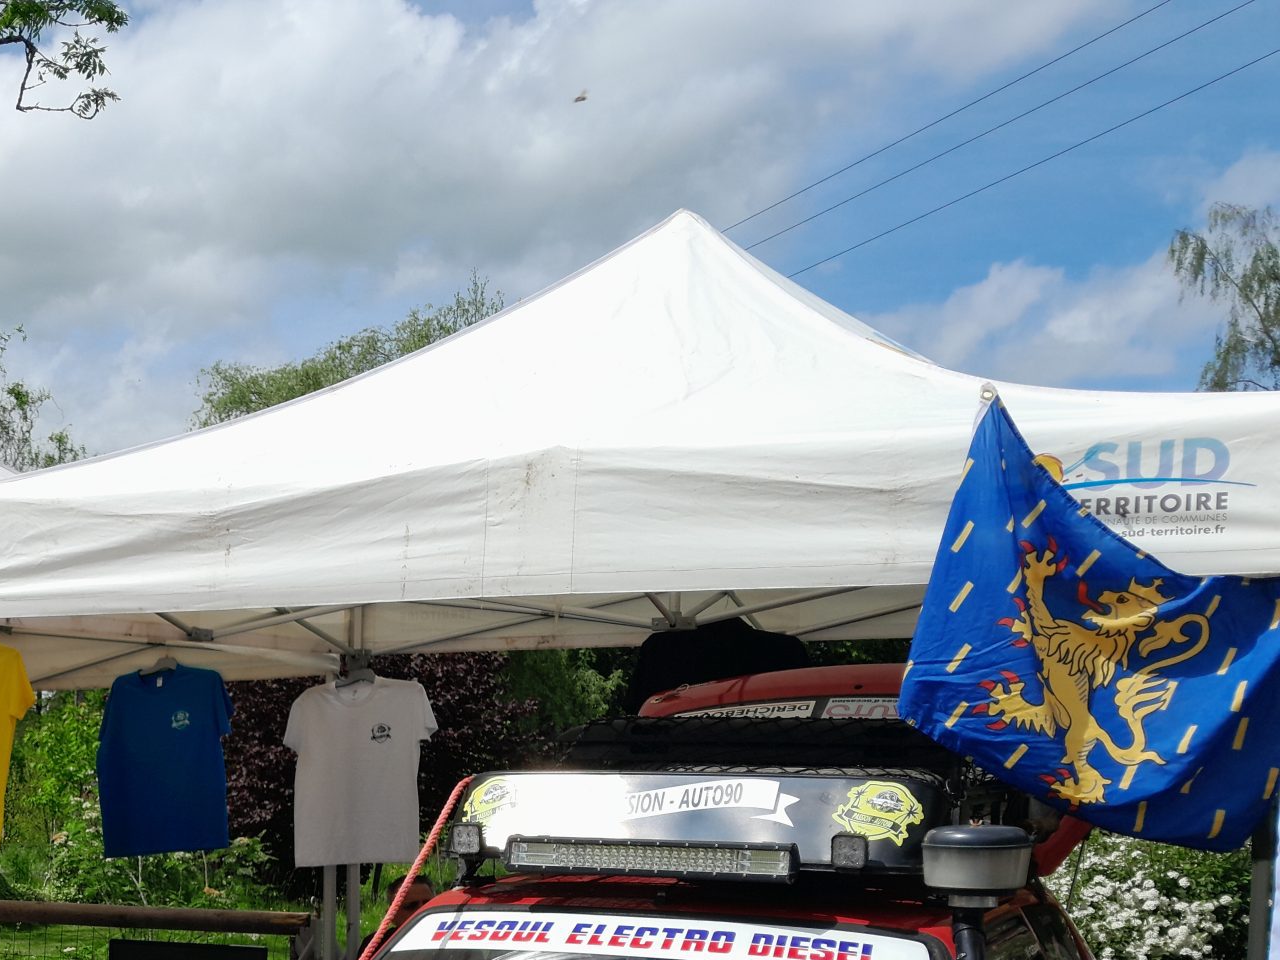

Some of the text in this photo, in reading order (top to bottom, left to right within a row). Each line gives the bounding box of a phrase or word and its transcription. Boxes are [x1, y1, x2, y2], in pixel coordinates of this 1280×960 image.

[1083, 437, 1230, 491] SUD
[1082, 491, 1228, 516] ERRITOIRE
[1118, 525, 1226, 537] -sud-territoire.fr
[1161, 513, 1227, 523] COMMUNES
[625, 782, 743, 814] SION AUTO90
[431, 919, 555, 943] VESOUL
[566, 922, 736, 954] ELECTRO
